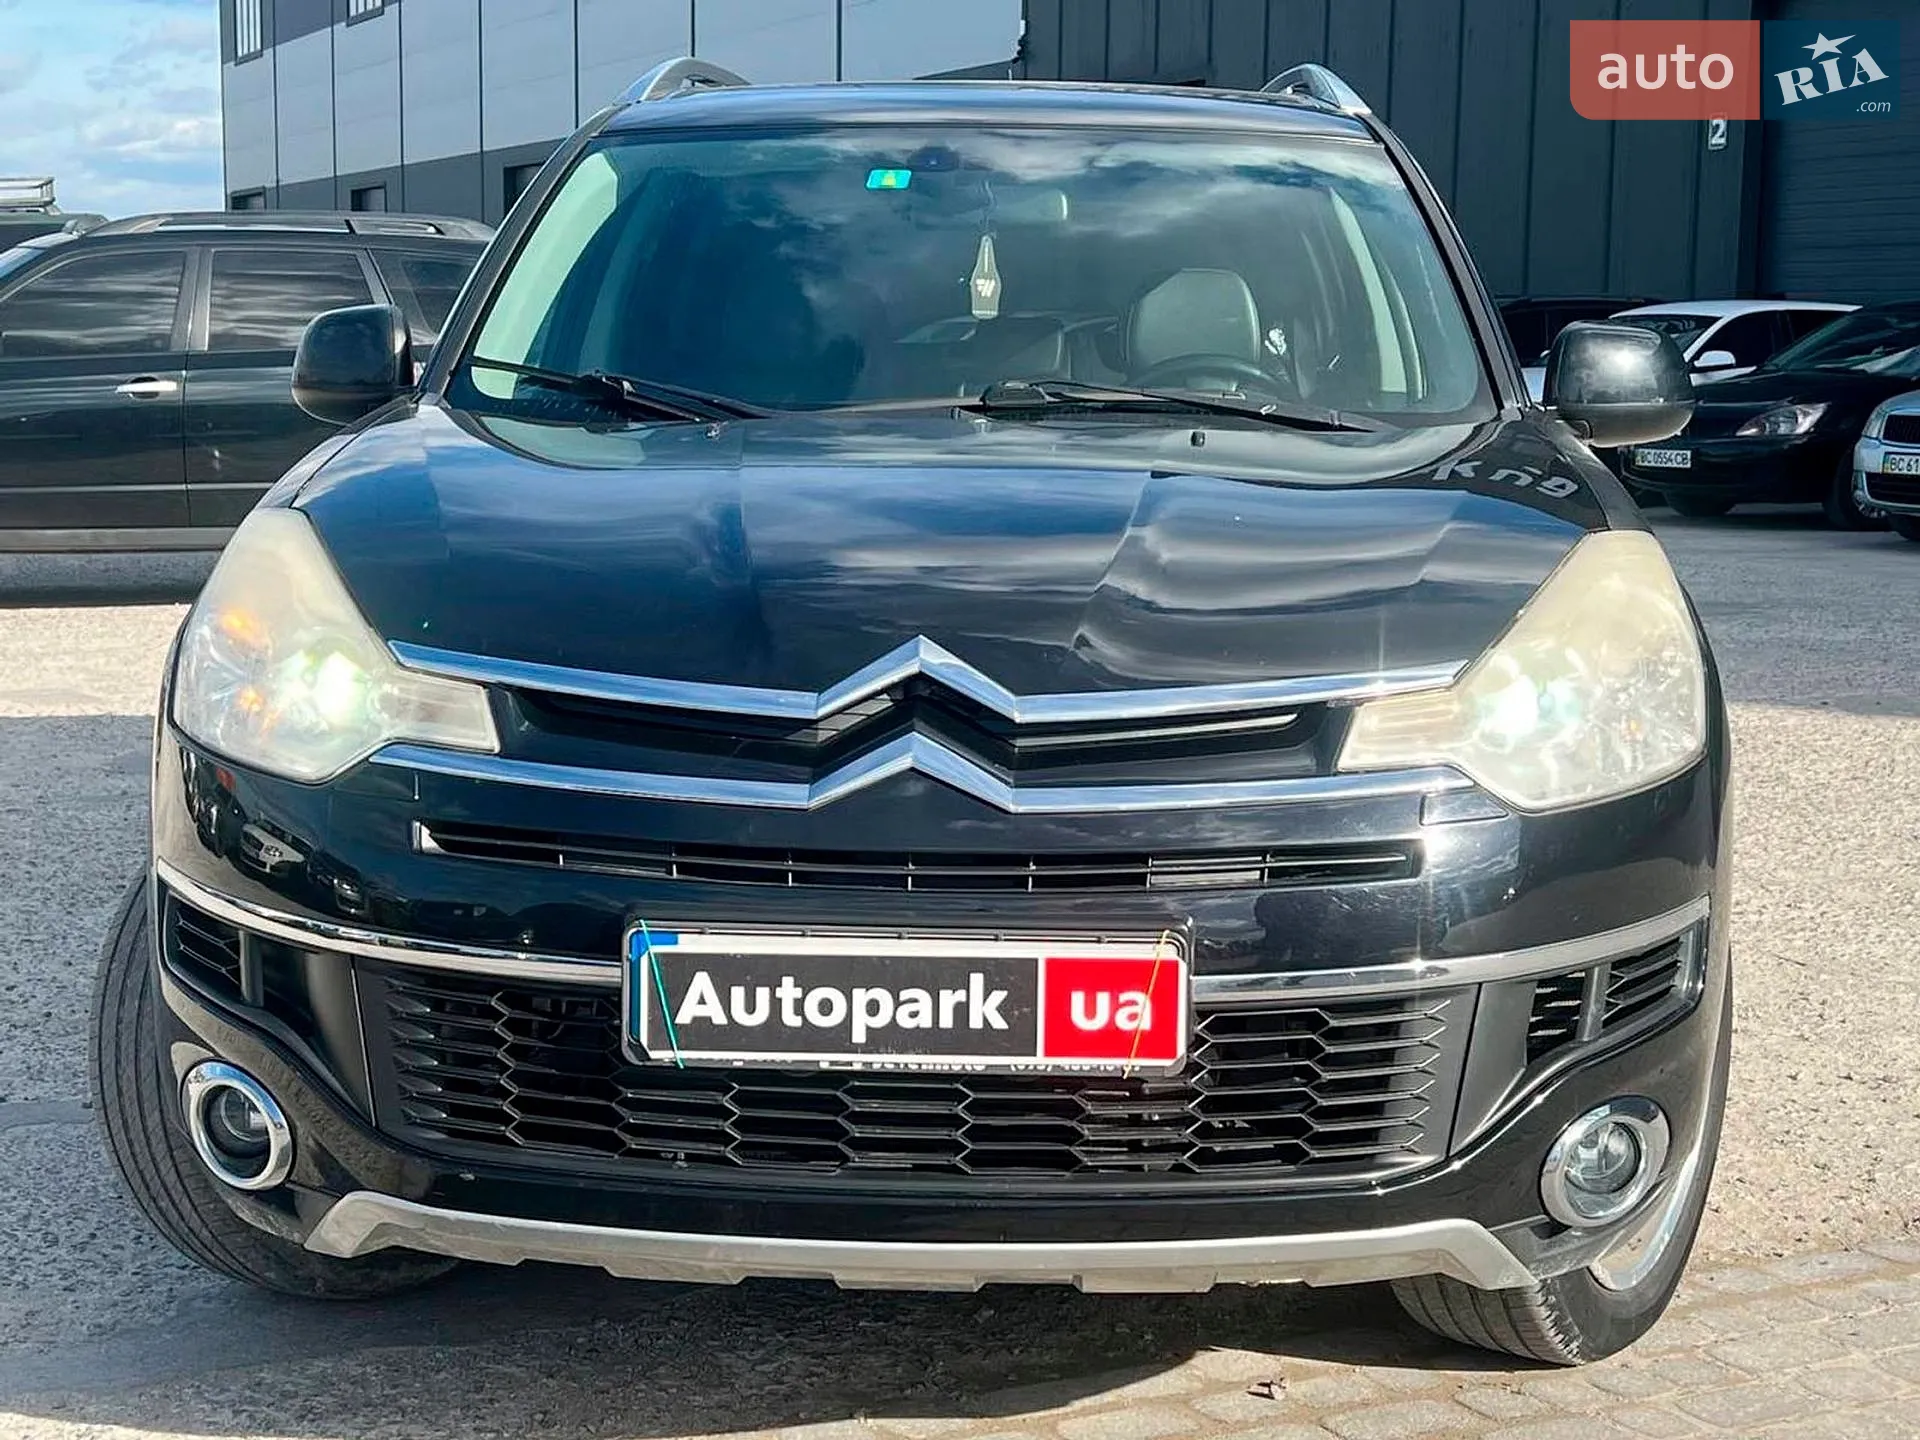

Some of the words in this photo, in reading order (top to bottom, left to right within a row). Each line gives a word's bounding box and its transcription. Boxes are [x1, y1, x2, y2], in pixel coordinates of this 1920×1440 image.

[1711, 119, 1726, 145] 2
[675, 970, 1009, 1044] Autopark
[1070, 989, 1152, 1032] ua
